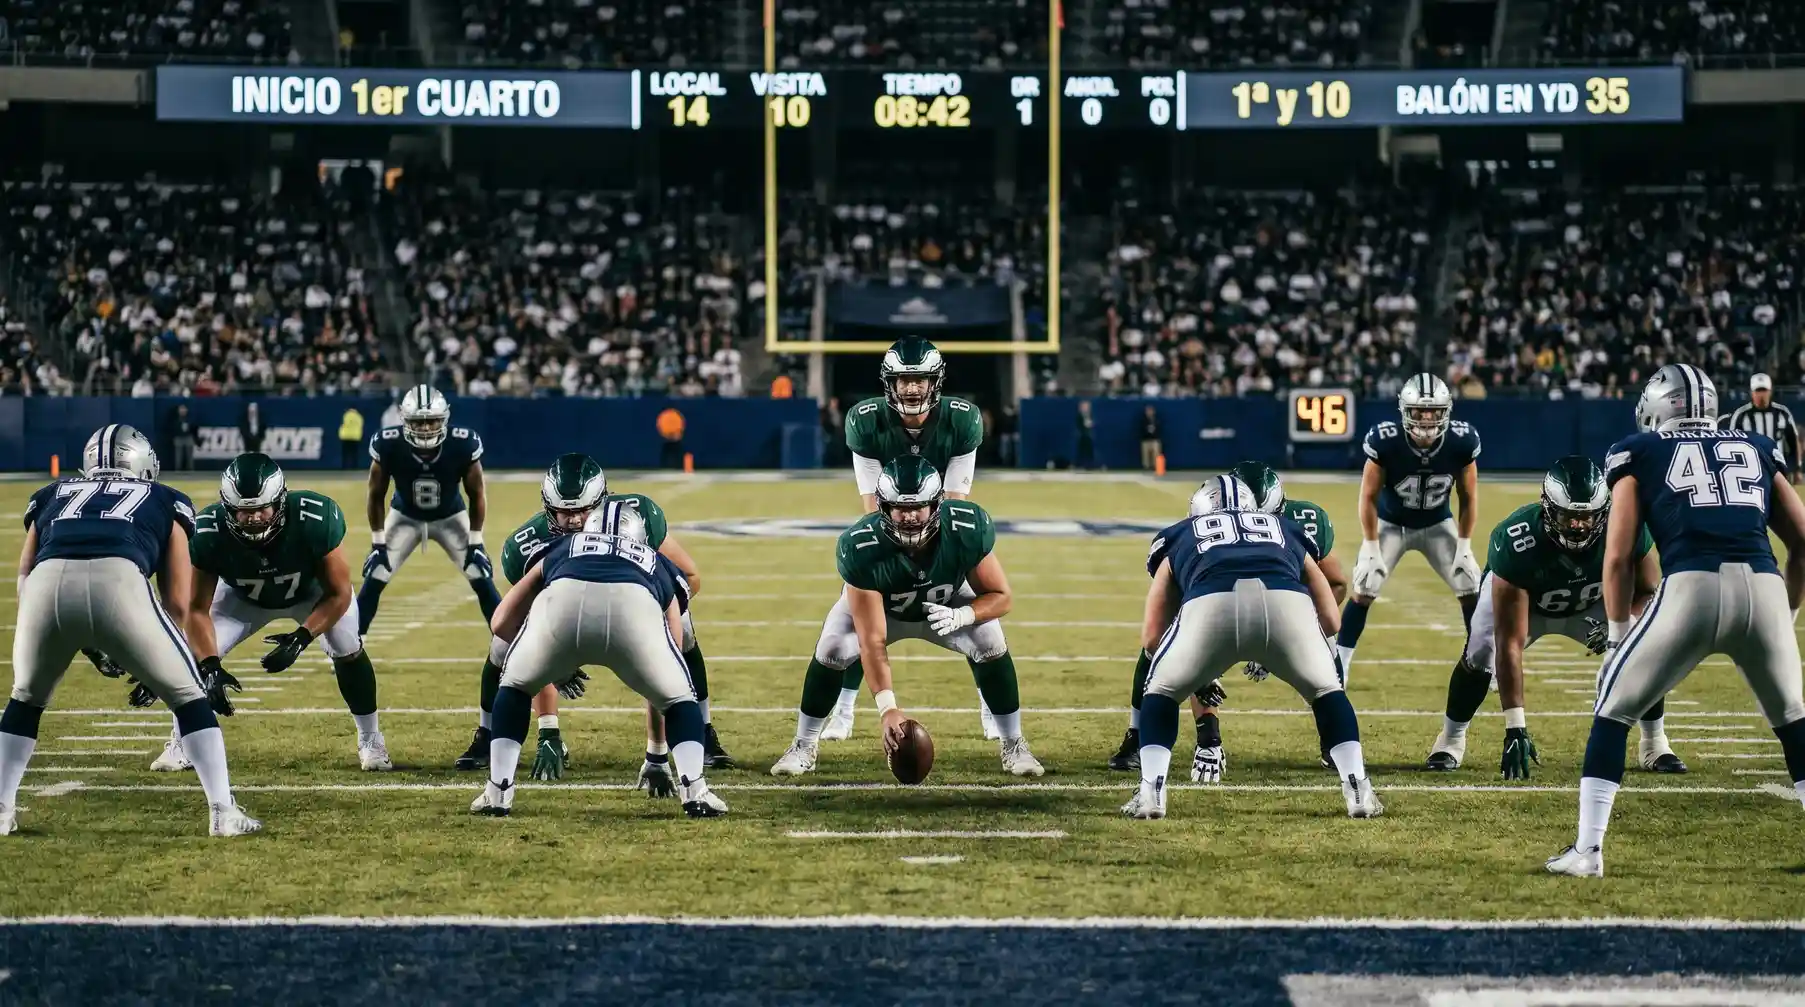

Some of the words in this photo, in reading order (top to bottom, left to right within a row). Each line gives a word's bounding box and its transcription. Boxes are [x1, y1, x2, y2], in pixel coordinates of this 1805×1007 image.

[233, 77, 341, 114] INICIO
[351, 79, 408, 115] 1er
[417, 79, 560, 117] CUARTO
[651, 72, 726, 95] LOCAL
[751, 72, 827, 95] VISITA
[883, 74, 961, 95] TIEMPO
[1397, 78, 1489, 114] BALÓN
[1496, 84, 1532, 113] EN
[1539, 83, 1578, 112] YD
[1586, 77, 1629, 113] 35
[669, 97, 709, 125] 14
[769, 95, 811, 127] 10
[875, 96, 969, 127] 08:42
[1017, 99, 1031, 124] 1
[1082, 98, 1102, 125] 0
[1150, 98, 1169, 124] 0
[1276, 89, 1297, 125] y
[1307, 81, 1350, 117] 10
[1297, 394, 1348, 435] 46
[193, 427, 323, 459] COOYS
[1393, 473, 1454, 509] 42
[1664, 441, 1765, 513] 42
[51, 481, 152, 526] 77
[300, 497, 323, 521] 77
[412, 478, 441, 510] 8
[950, 507, 976, 531] 77
[1192, 512, 1286, 554] 99
[850, 524, 880, 550] 77
[1506, 521, 1537, 553] 68
[236, 571, 302, 601] 77
